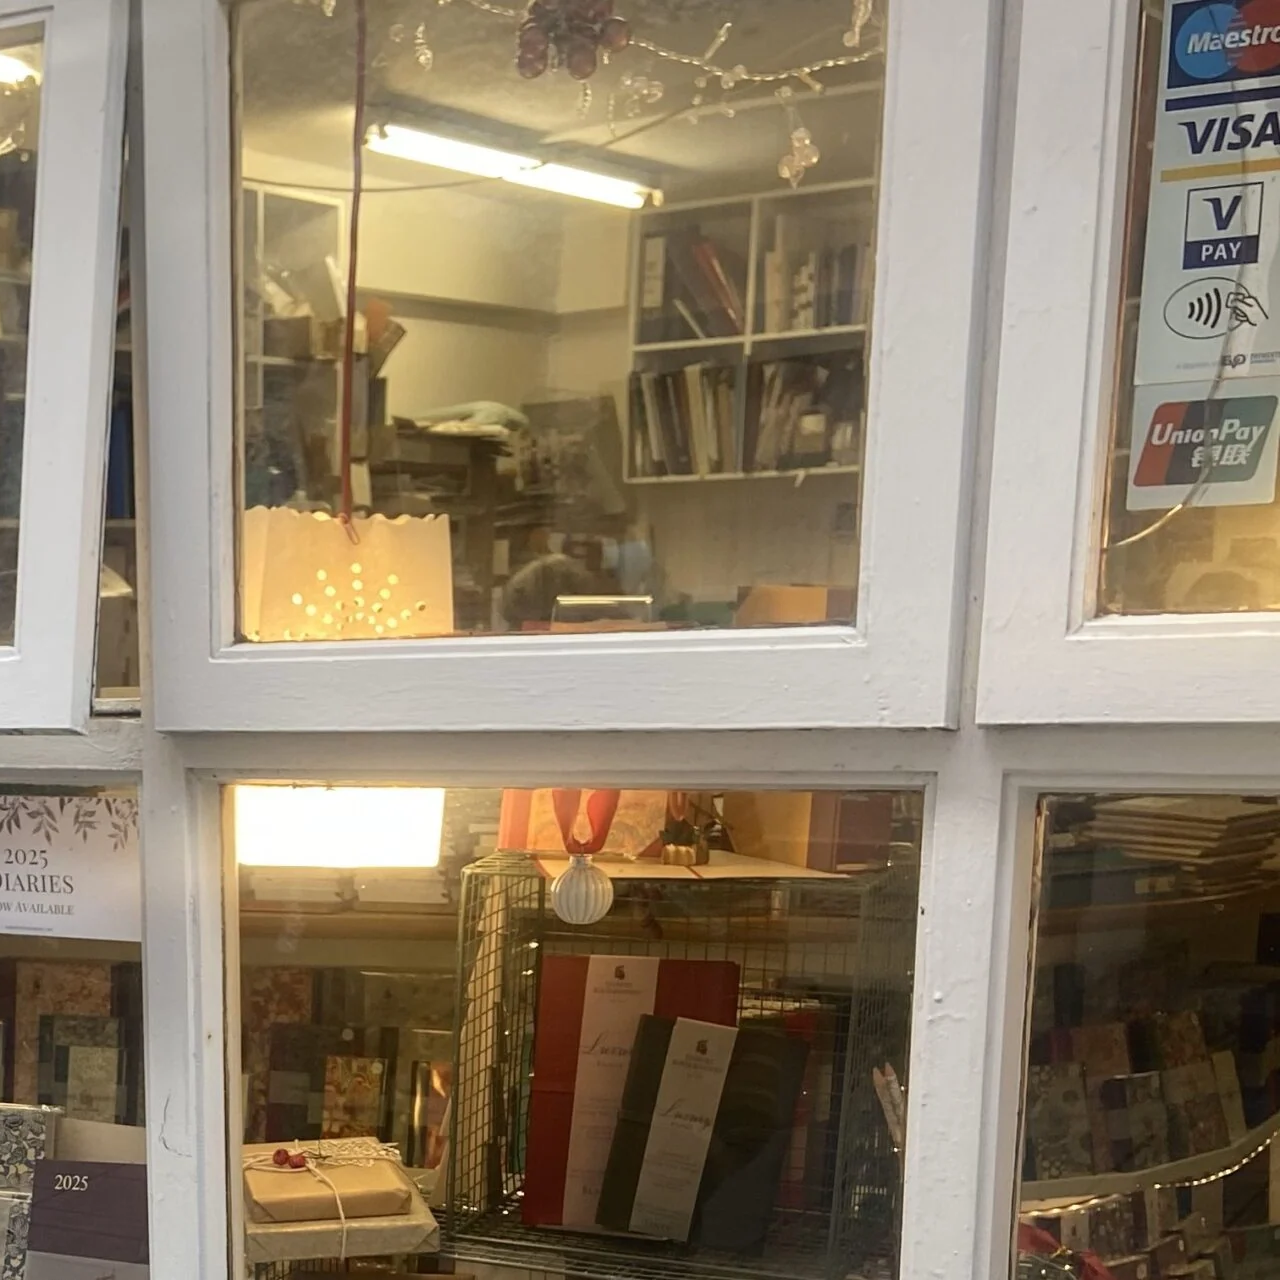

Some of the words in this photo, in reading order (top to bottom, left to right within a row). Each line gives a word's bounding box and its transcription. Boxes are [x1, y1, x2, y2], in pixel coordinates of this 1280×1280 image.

[1187, 24, 1280, 54] Maestro
[1177, 111, 1280, 155] VISA
[1202, 195, 1242, 231] V
[1201, 241, 1241, 262] PAY
[1151, 418, 1265, 452] UnionPay
[4, 848, 48, 869] 2025
[54, 1174, 89, 1191] 2025
